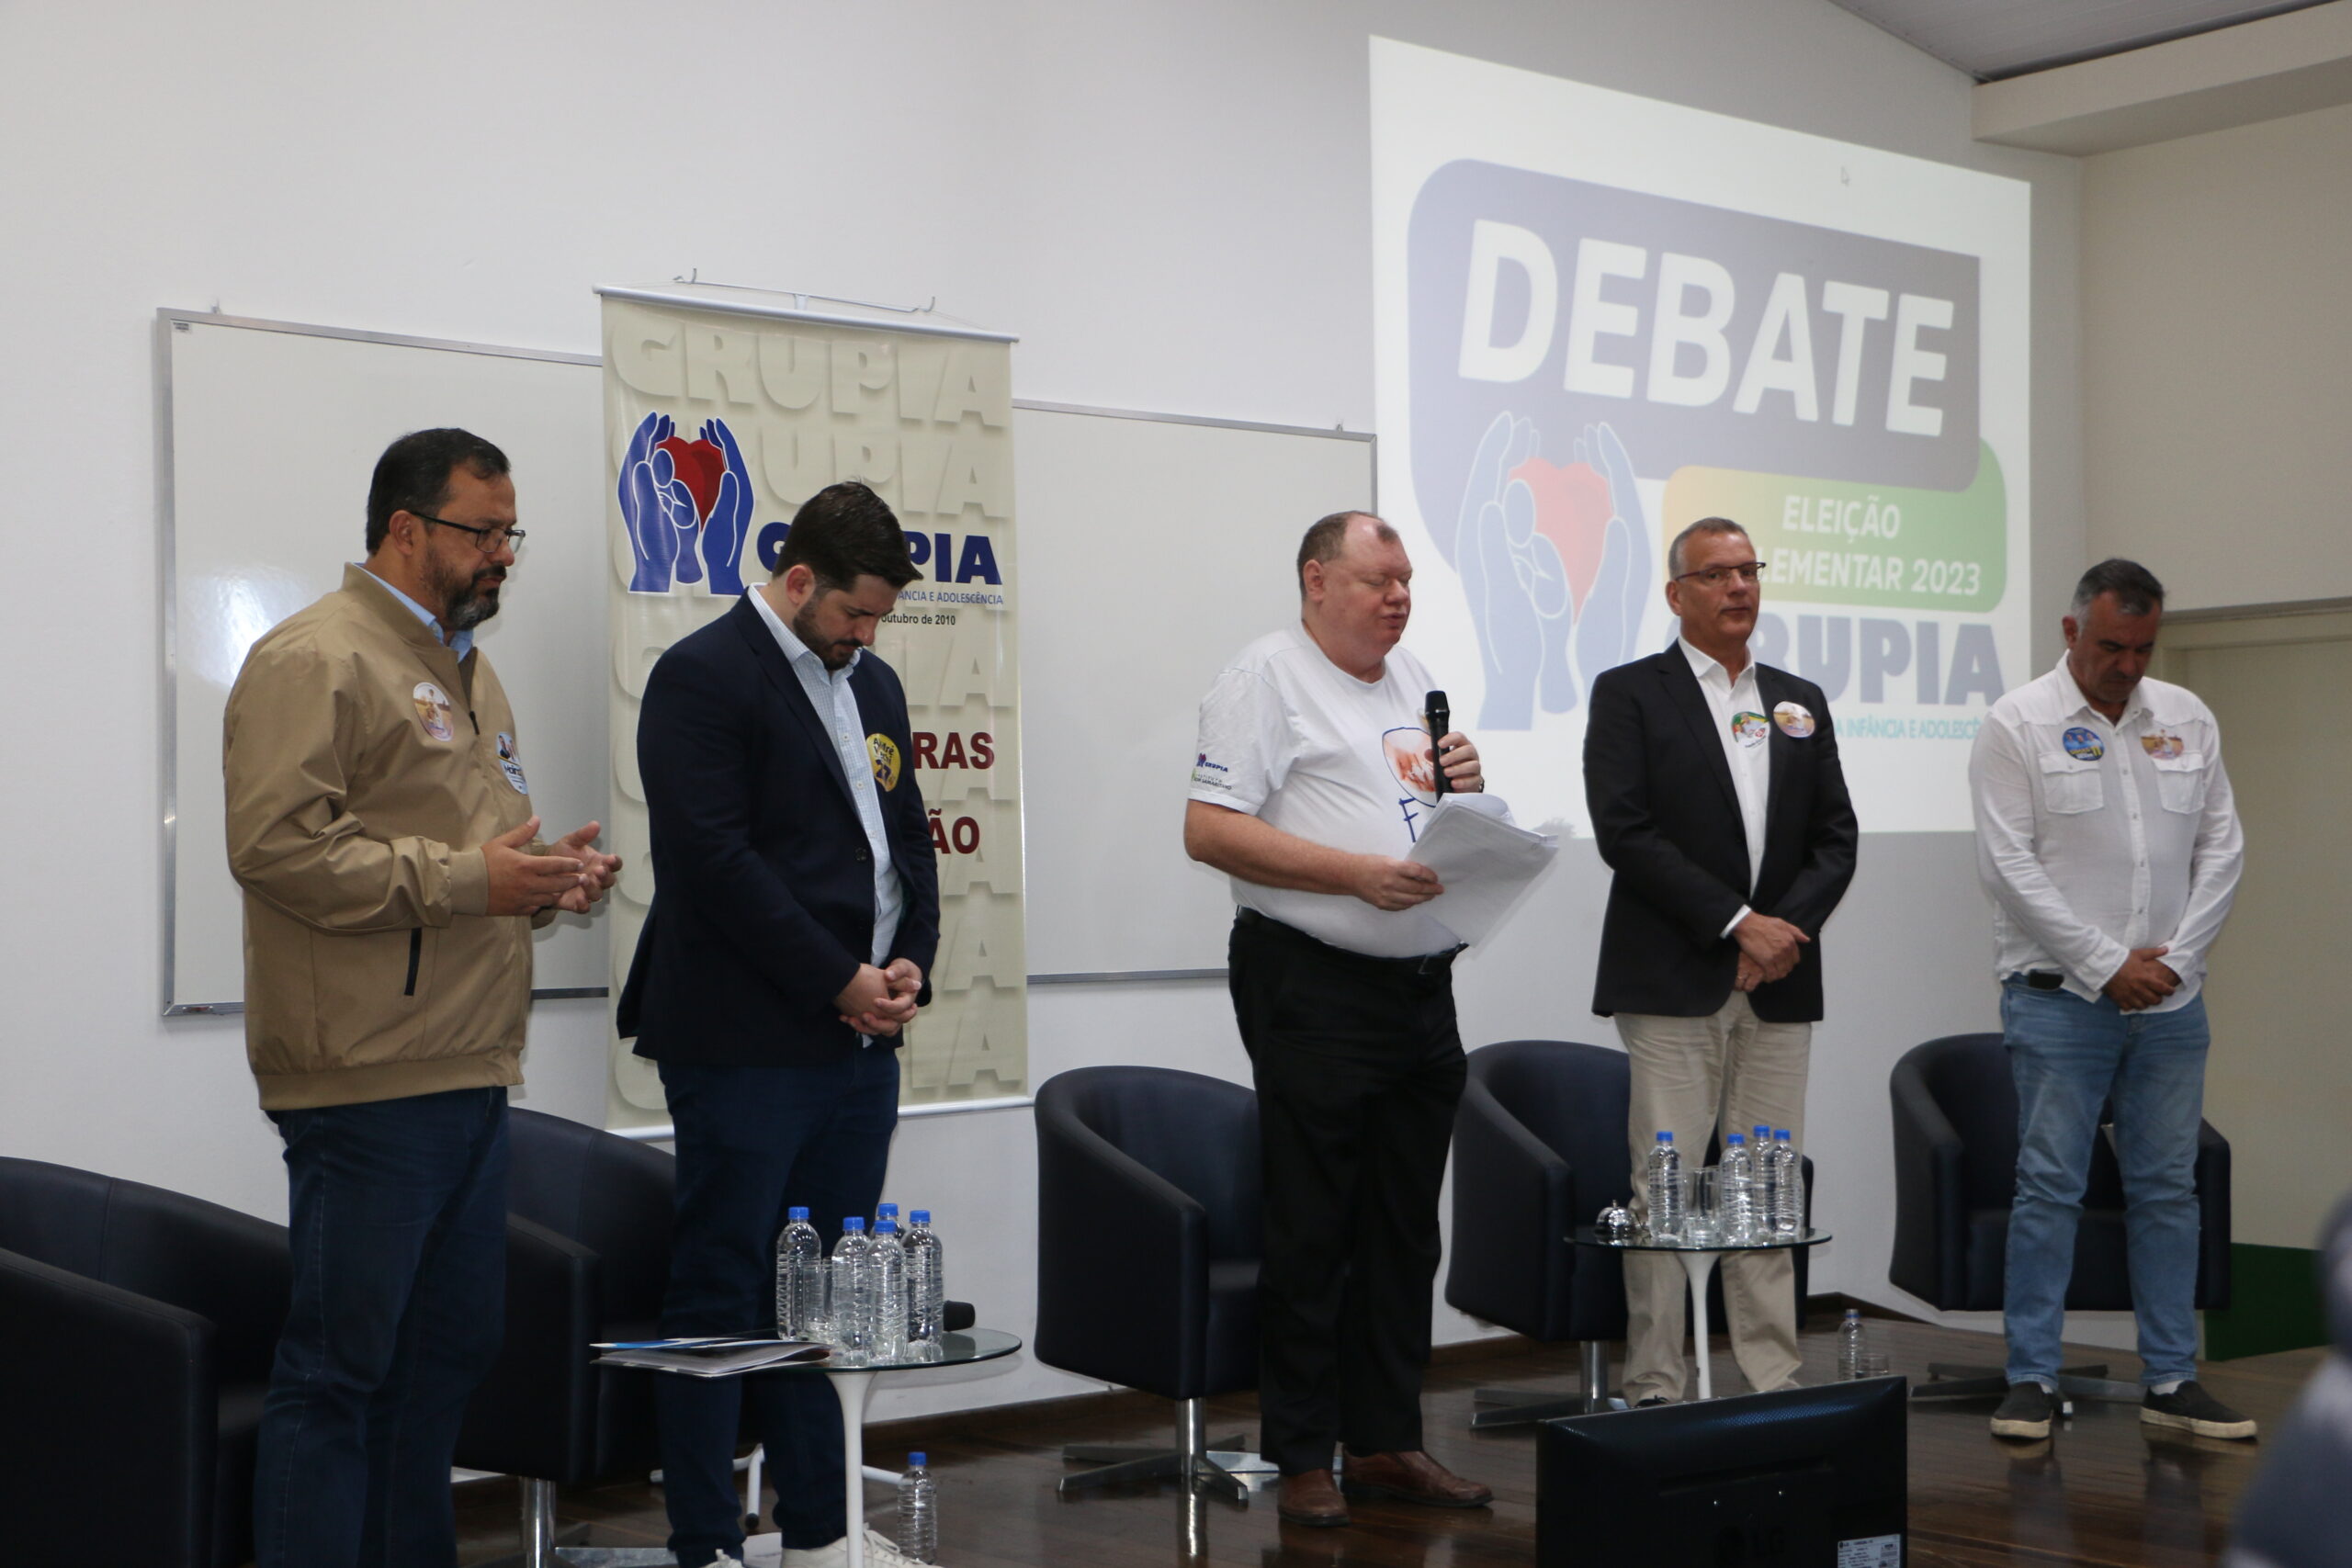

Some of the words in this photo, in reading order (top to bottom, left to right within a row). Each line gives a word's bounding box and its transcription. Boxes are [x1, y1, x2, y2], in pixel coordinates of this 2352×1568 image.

[1458, 219, 1954, 436] DEBATE
[1782, 494, 1901, 544] ELEIÇÃO
[757, 522, 1003, 585] GPIA
[1756, 547, 1904, 591] LEMENTAR
[1910, 558, 1982, 596] 2023
[881, 613, 919, 624] outubro
[922, 615, 933, 625] de
[935, 615, 956, 626] 2010
[929, 592, 934, 602] E
[937, 592, 1003, 604] ADOLESCÊNCIA
[1665, 612, 2006, 706] RUPIA
[912, 731, 995, 770] RAS
[928, 808, 980, 854] ÃO
